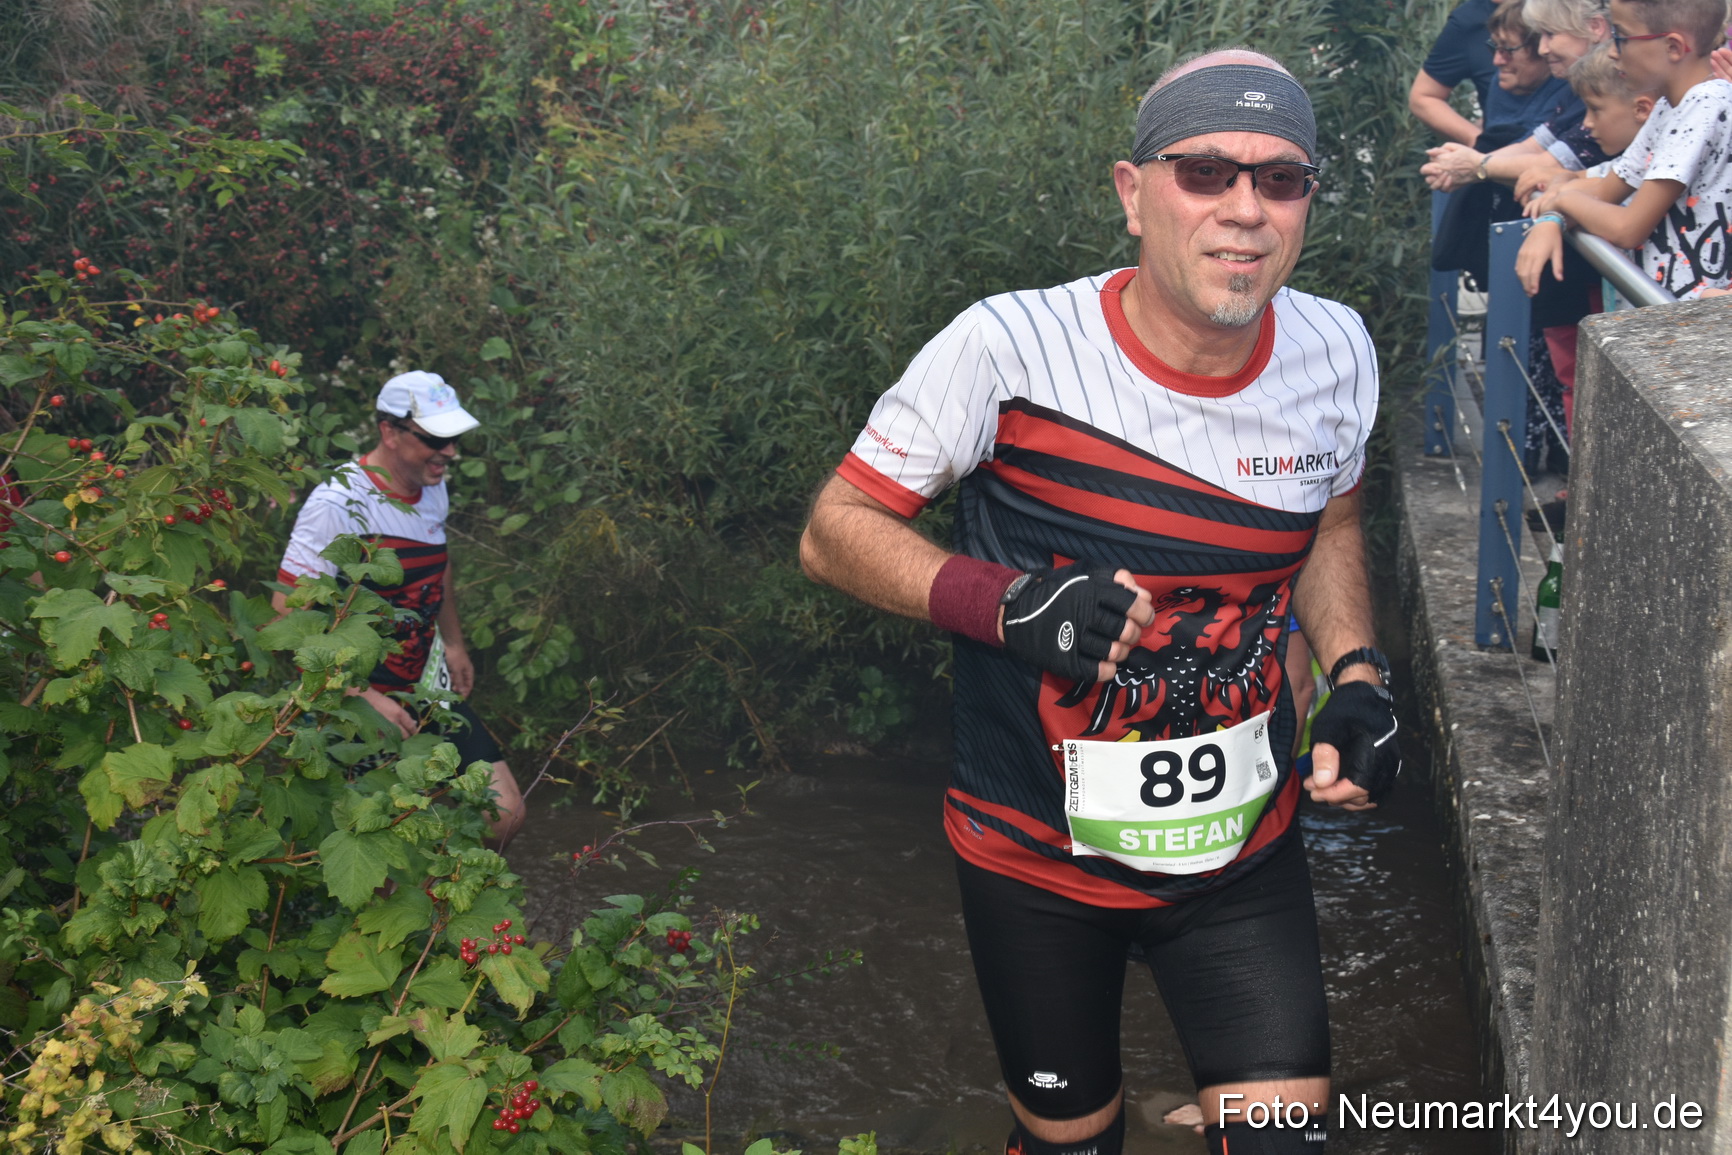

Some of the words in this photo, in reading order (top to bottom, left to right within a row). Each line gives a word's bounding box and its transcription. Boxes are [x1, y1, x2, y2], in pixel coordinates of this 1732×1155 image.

[1300, 478, 1320, 487] STARKE
[1139, 743, 1226, 808] 89
[1119, 813, 1243, 851] STEFAN
